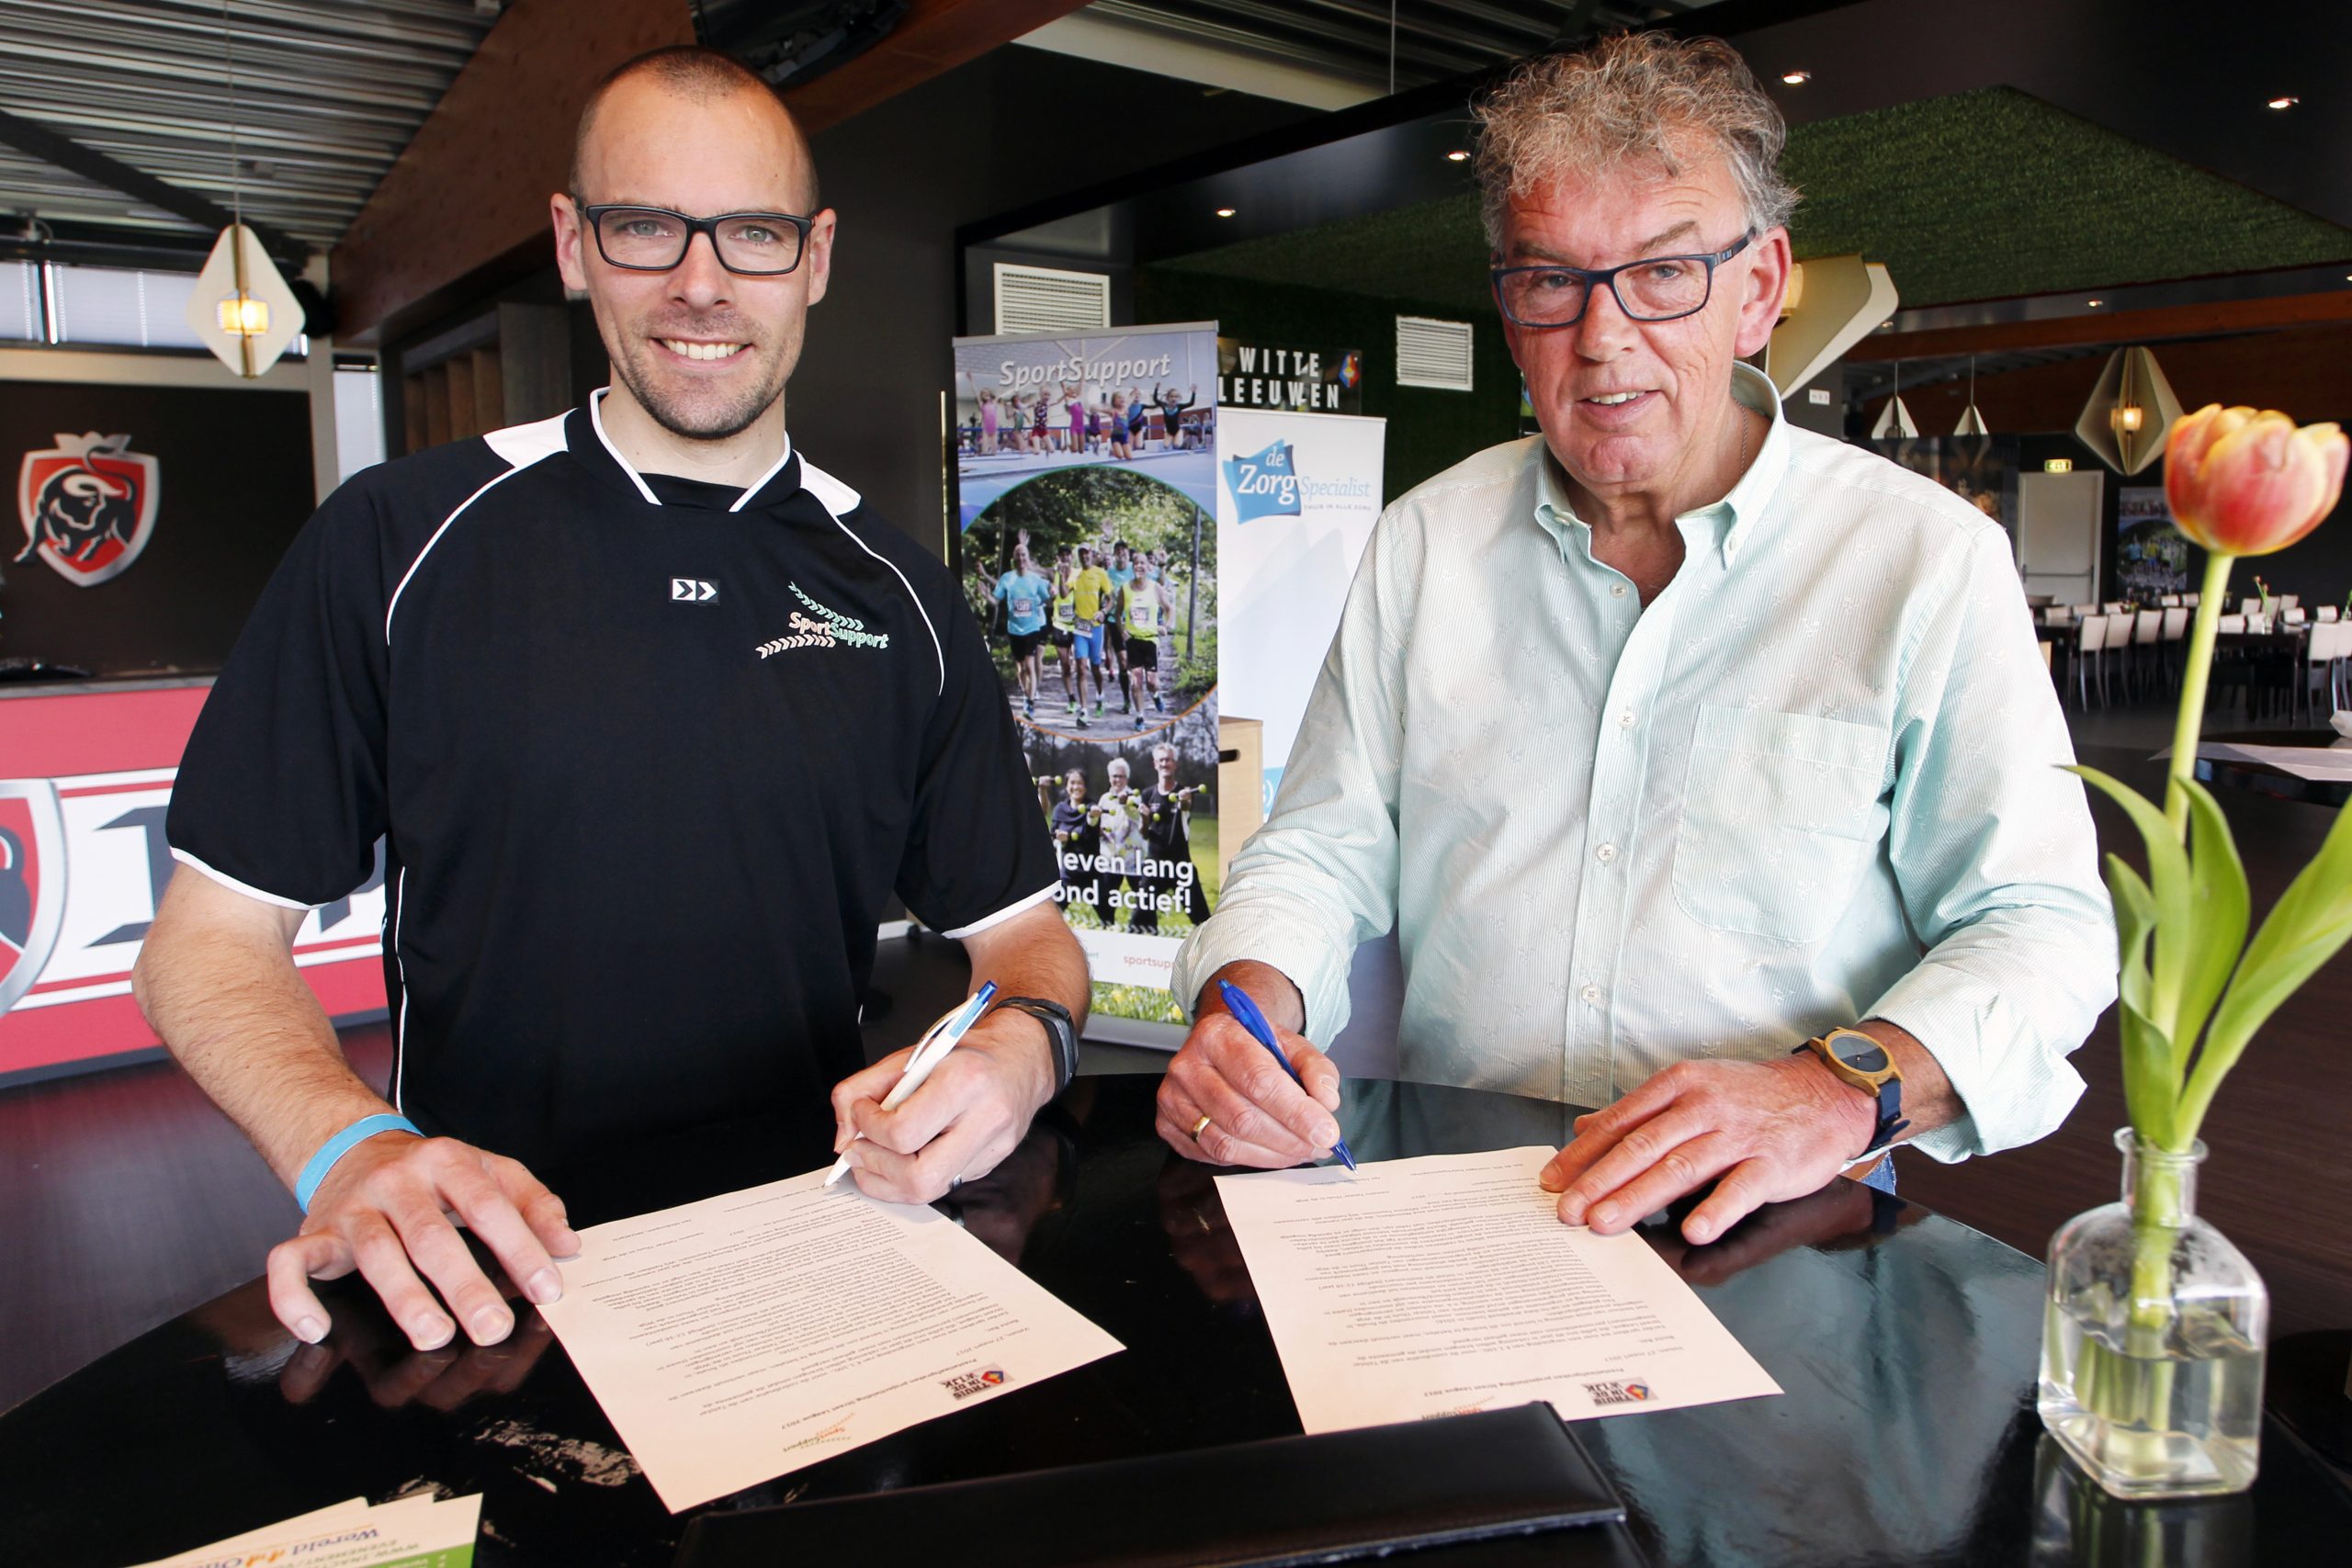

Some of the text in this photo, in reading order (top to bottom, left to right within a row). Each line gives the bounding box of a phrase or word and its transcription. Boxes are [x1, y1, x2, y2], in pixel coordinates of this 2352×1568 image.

[1000, 353, 1171, 391] SportSupport
[1238, 346, 1320, 378] WITTE
[1218, 376, 1339, 410] LEEUWEN
[1265, 446, 1284, 468] de
[1237, 464, 1372, 506] Zorg Specialist
[789, 612, 888, 649] SportSupport
[1057, 842, 1194, 887] leven lang
[1053, 879, 1192, 914] ond actief!
[1123, 955, 1175, 970] sportsup
[950, 1378, 982, 1392] IN DE
[950, 1382, 989, 1398] THUIS
[1592, 1394, 1633, 1404] THUIS
[780, 1426, 846, 1452] SportSupport
